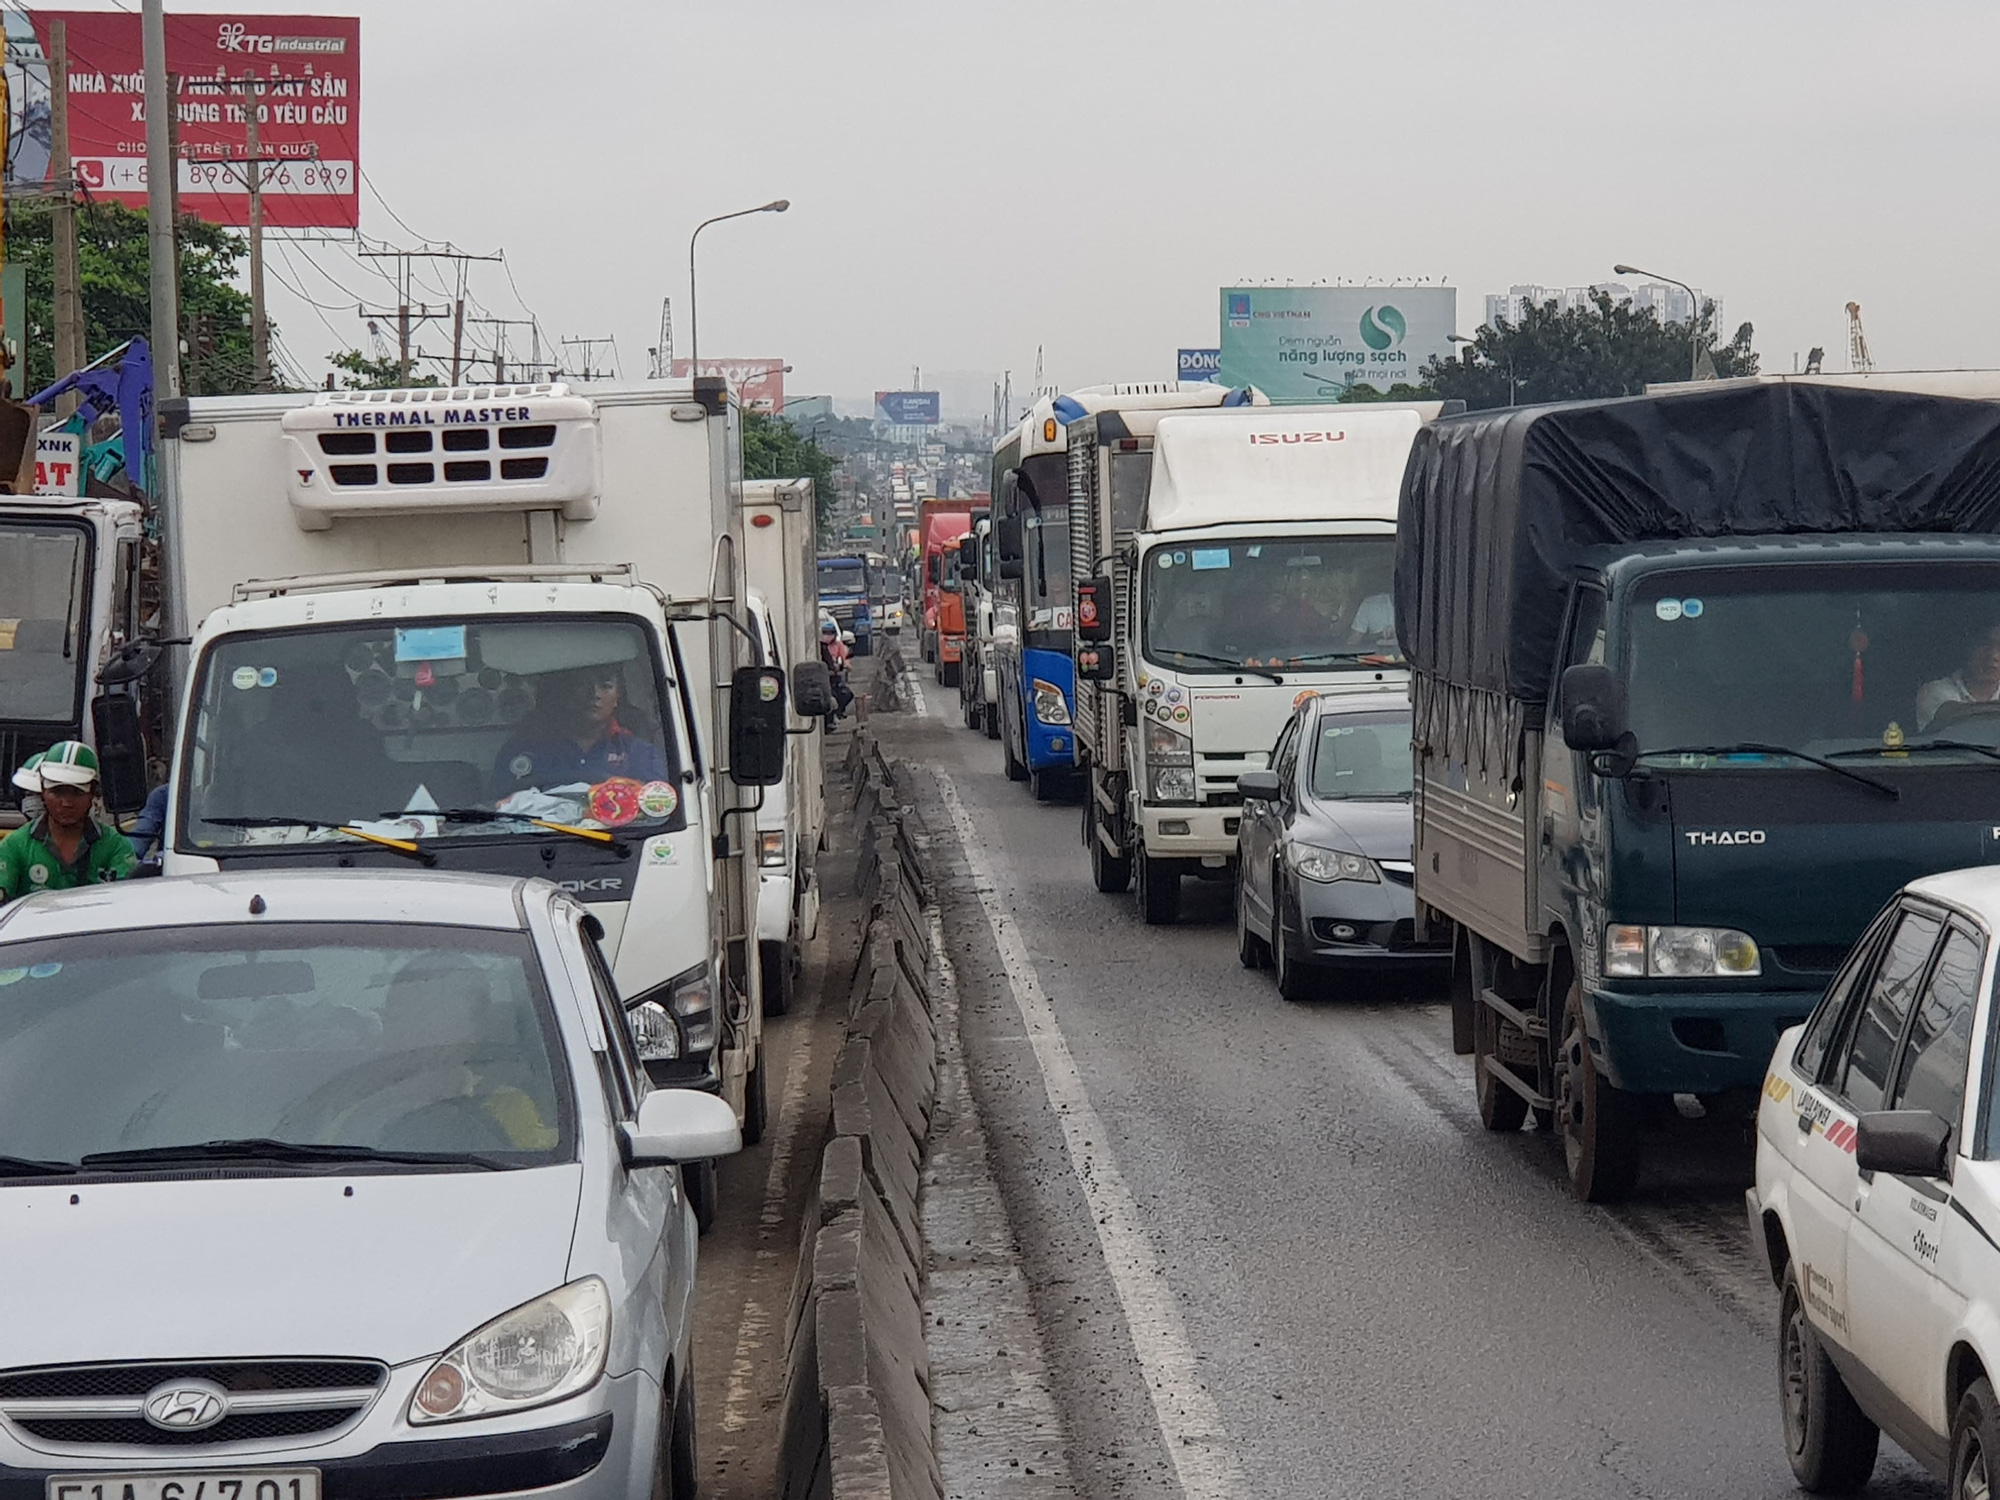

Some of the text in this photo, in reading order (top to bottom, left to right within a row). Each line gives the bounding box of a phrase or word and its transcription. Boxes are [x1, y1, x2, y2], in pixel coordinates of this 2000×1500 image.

[227, 35, 345, 53] KTG Industrial
[68, 70, 107, 93] NHÀ
[230, 75, 266, 96] KO
[224, 105, 269, 123] THO
[274, 101, 307, 124] YÊU
[236, 141, 275, 155] TÀN
[190, 166, 233, 185] 896
[262, 167, 290, 186] 96
[304, 167, 347, 186] 899
[1279, 349, 1407, 365] năng lượng sạch
[333, 406, 530, 427] THERMAL MASTER
[37, 439, 72, 452] XNK
[1250, 431, 1345, 444] ISUZU
[1685, 830, 1766, 845] THACO
[558, 878, 622, 892] QKR
